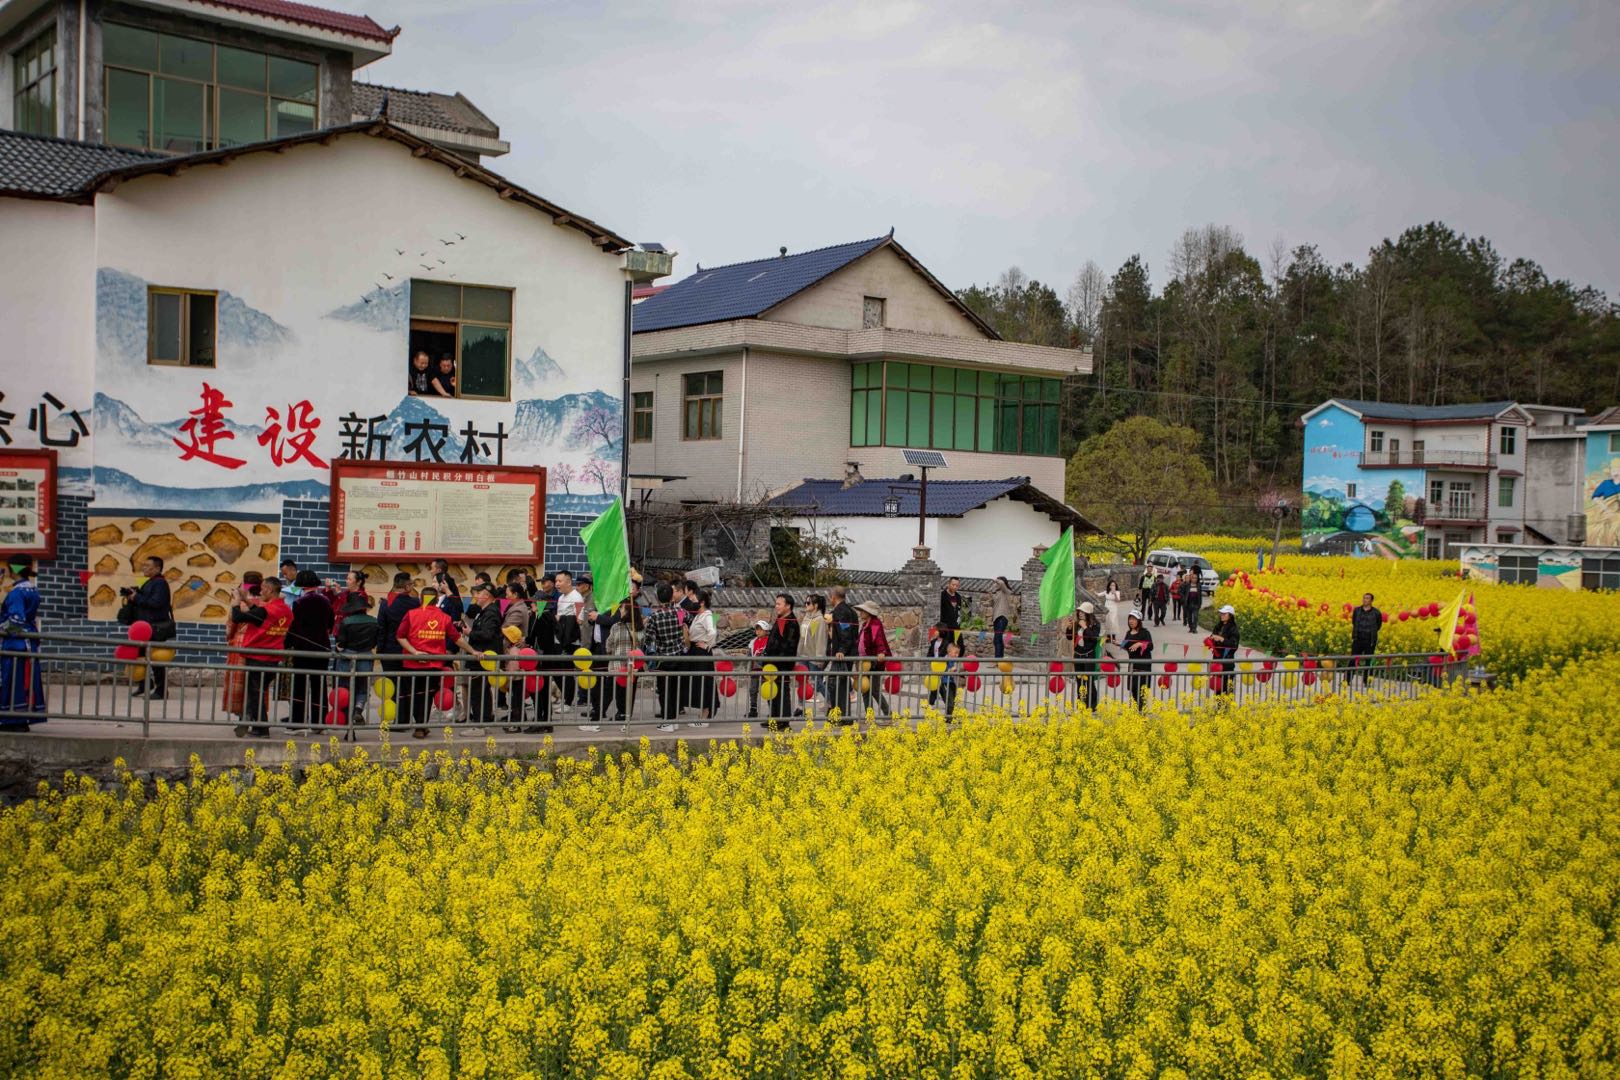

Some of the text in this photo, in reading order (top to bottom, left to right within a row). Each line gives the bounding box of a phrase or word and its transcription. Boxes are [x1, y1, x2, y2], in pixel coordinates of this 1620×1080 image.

[172, 382, 509, 470] 建设新农村
